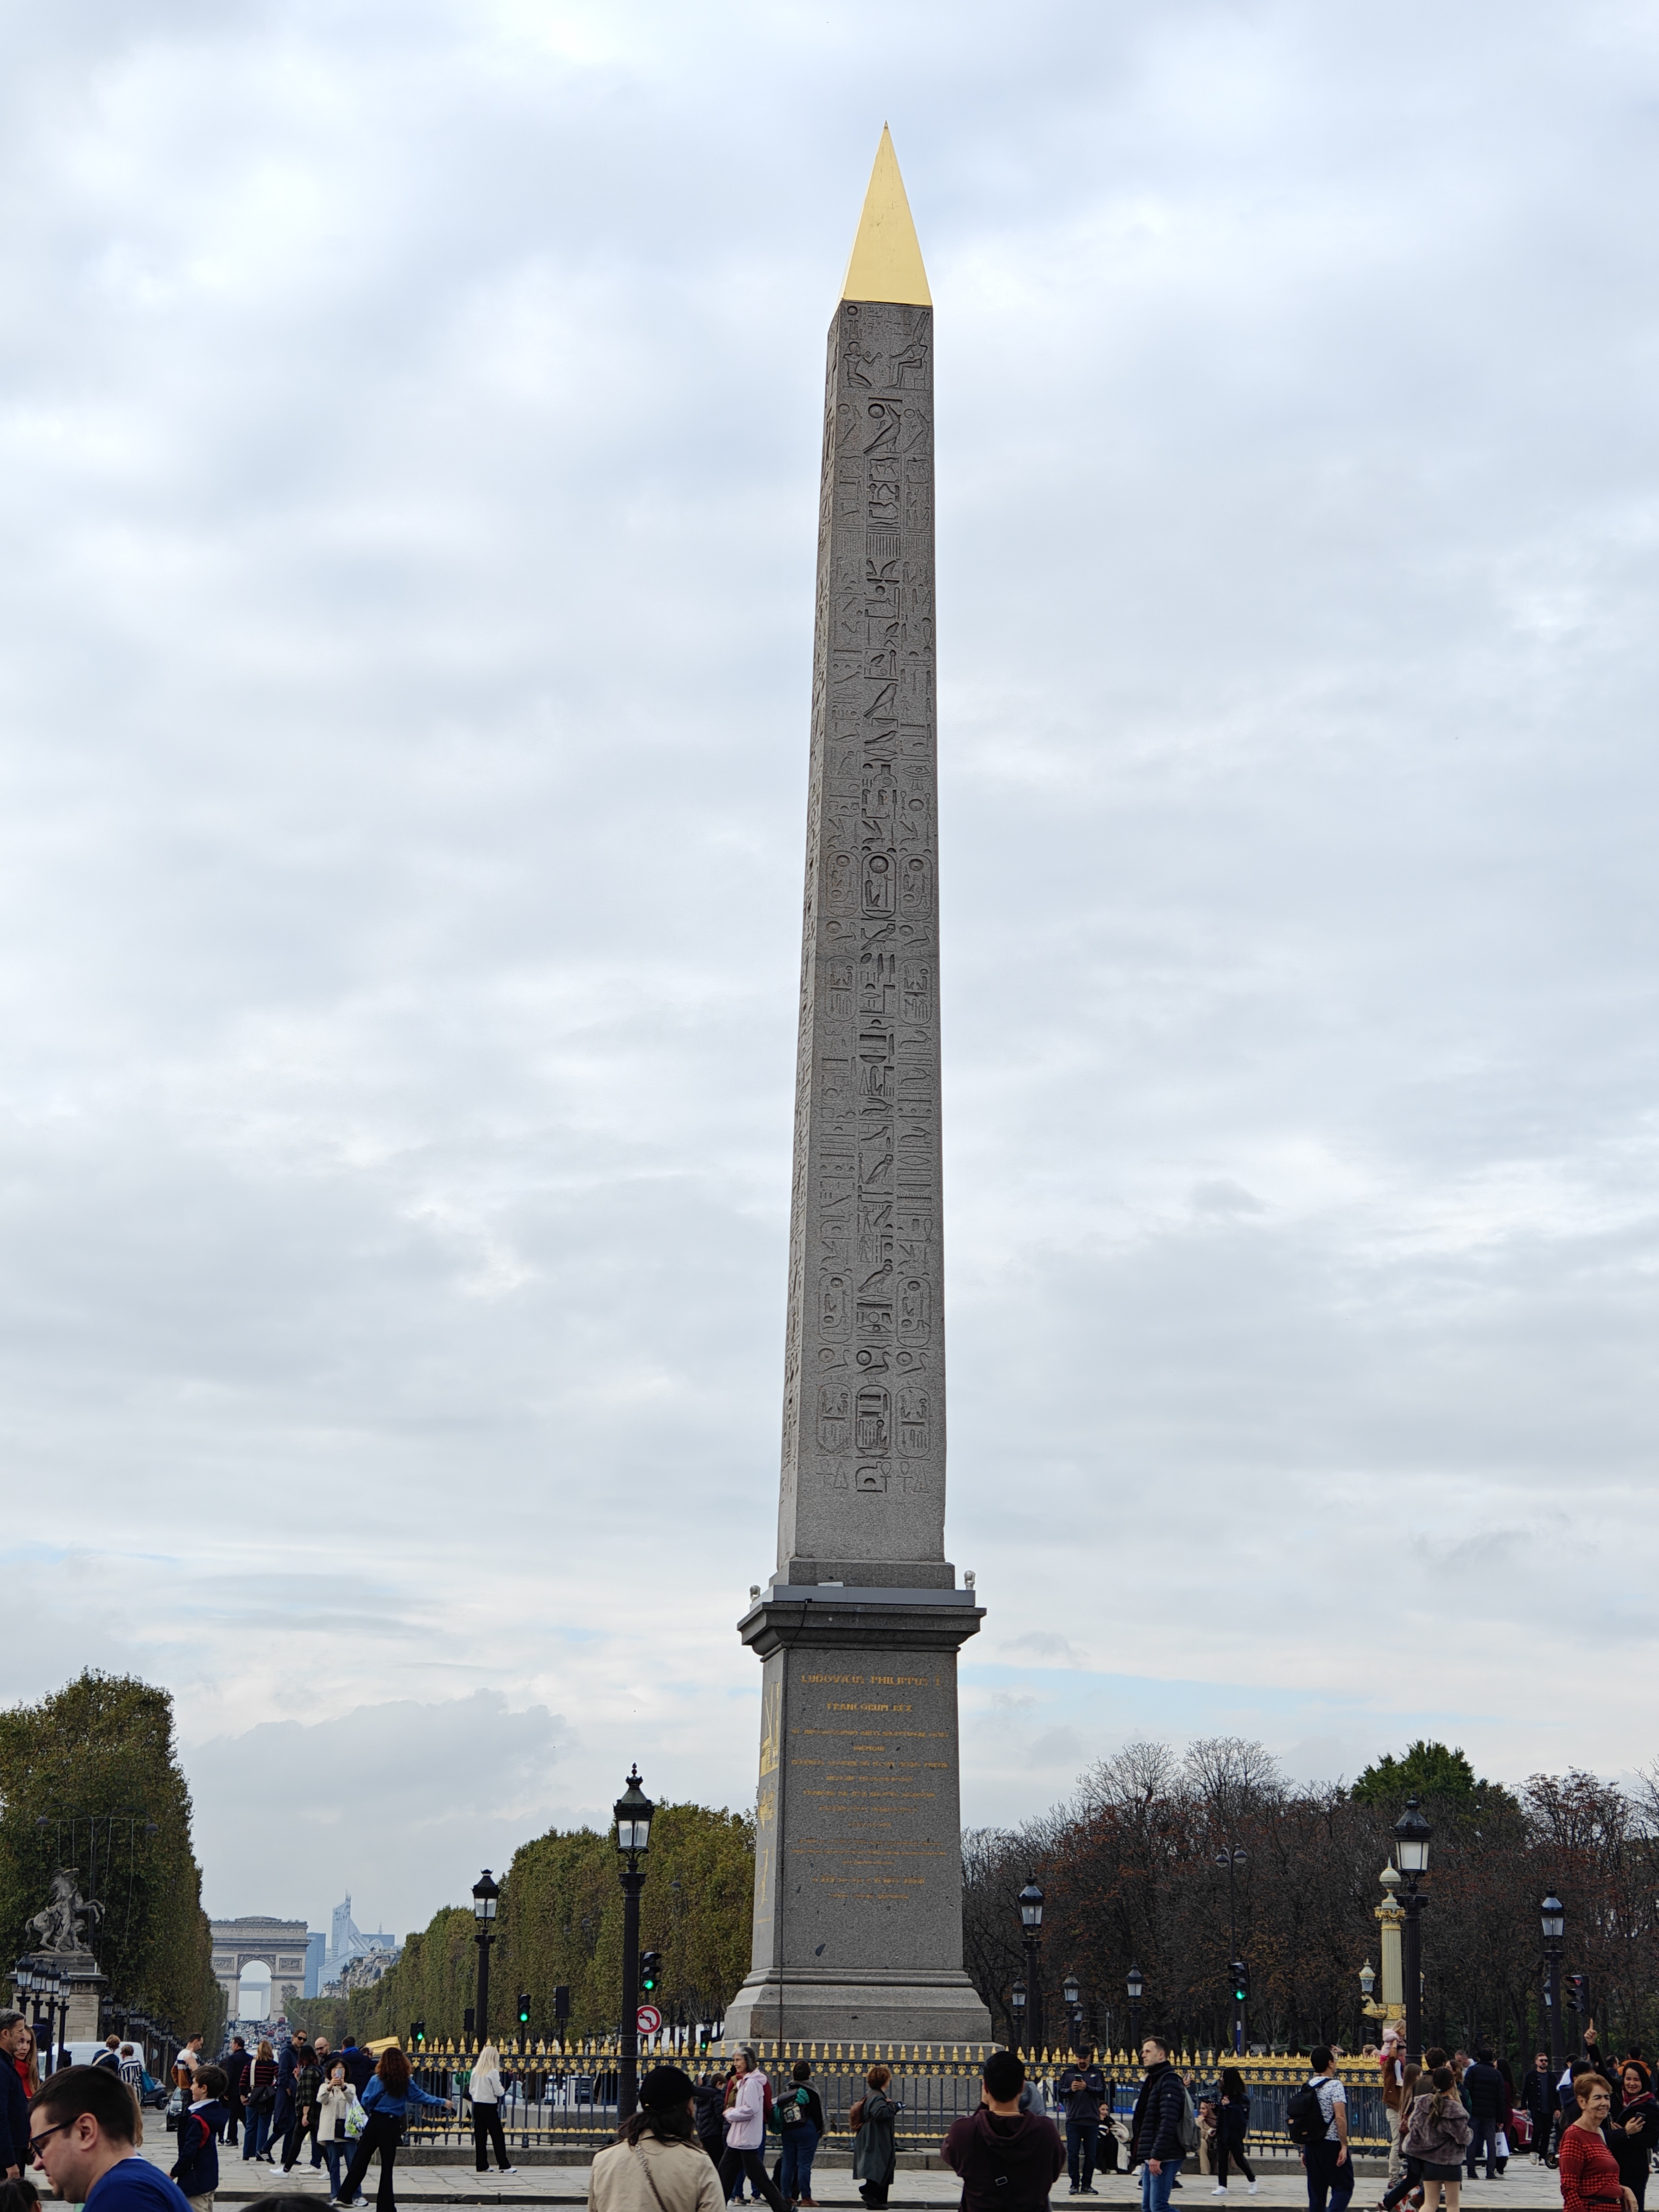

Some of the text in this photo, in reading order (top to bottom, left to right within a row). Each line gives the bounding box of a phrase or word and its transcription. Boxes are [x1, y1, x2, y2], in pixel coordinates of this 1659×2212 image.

[871, 1675, 928, 1685] PHILIPPUS
[827, 1702, 913, 1712] FRANCORUM REX
